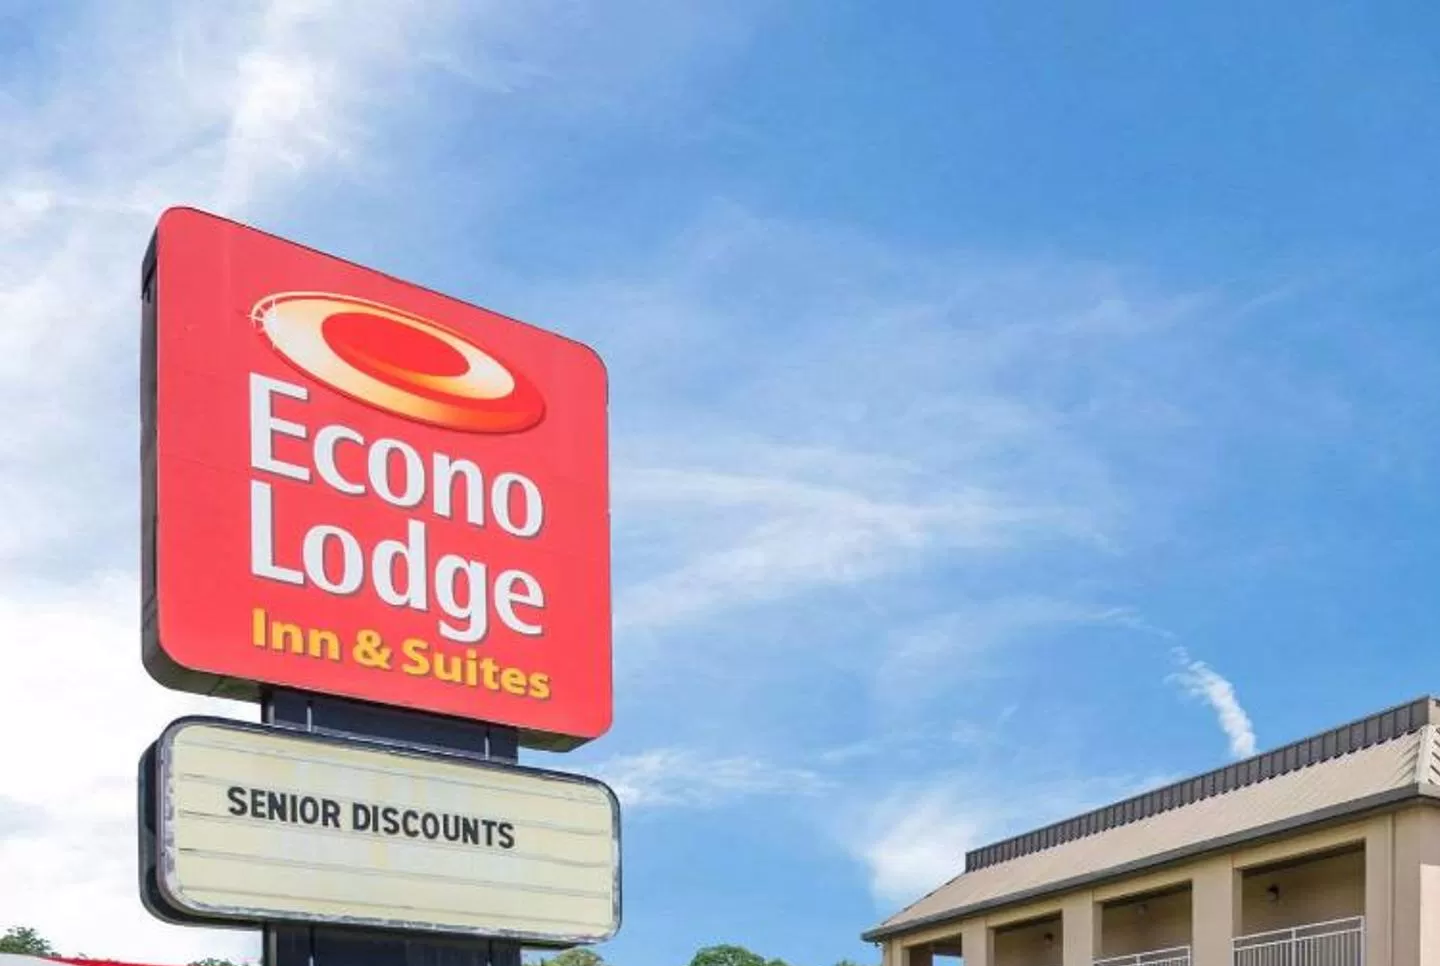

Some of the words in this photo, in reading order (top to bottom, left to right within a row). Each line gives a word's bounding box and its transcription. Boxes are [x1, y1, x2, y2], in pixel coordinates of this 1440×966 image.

[249, 372, 545, 538] Econo
[250, 480, 546, 644] Lodge
[252, 608, 341, 660] Inn
[353, 629, 391, 669] &
[403, 638, 550, 699] Suites
[227, 786, 342, 829] SENIOR
[352, 802, 516, 849] DISCOUNTS
